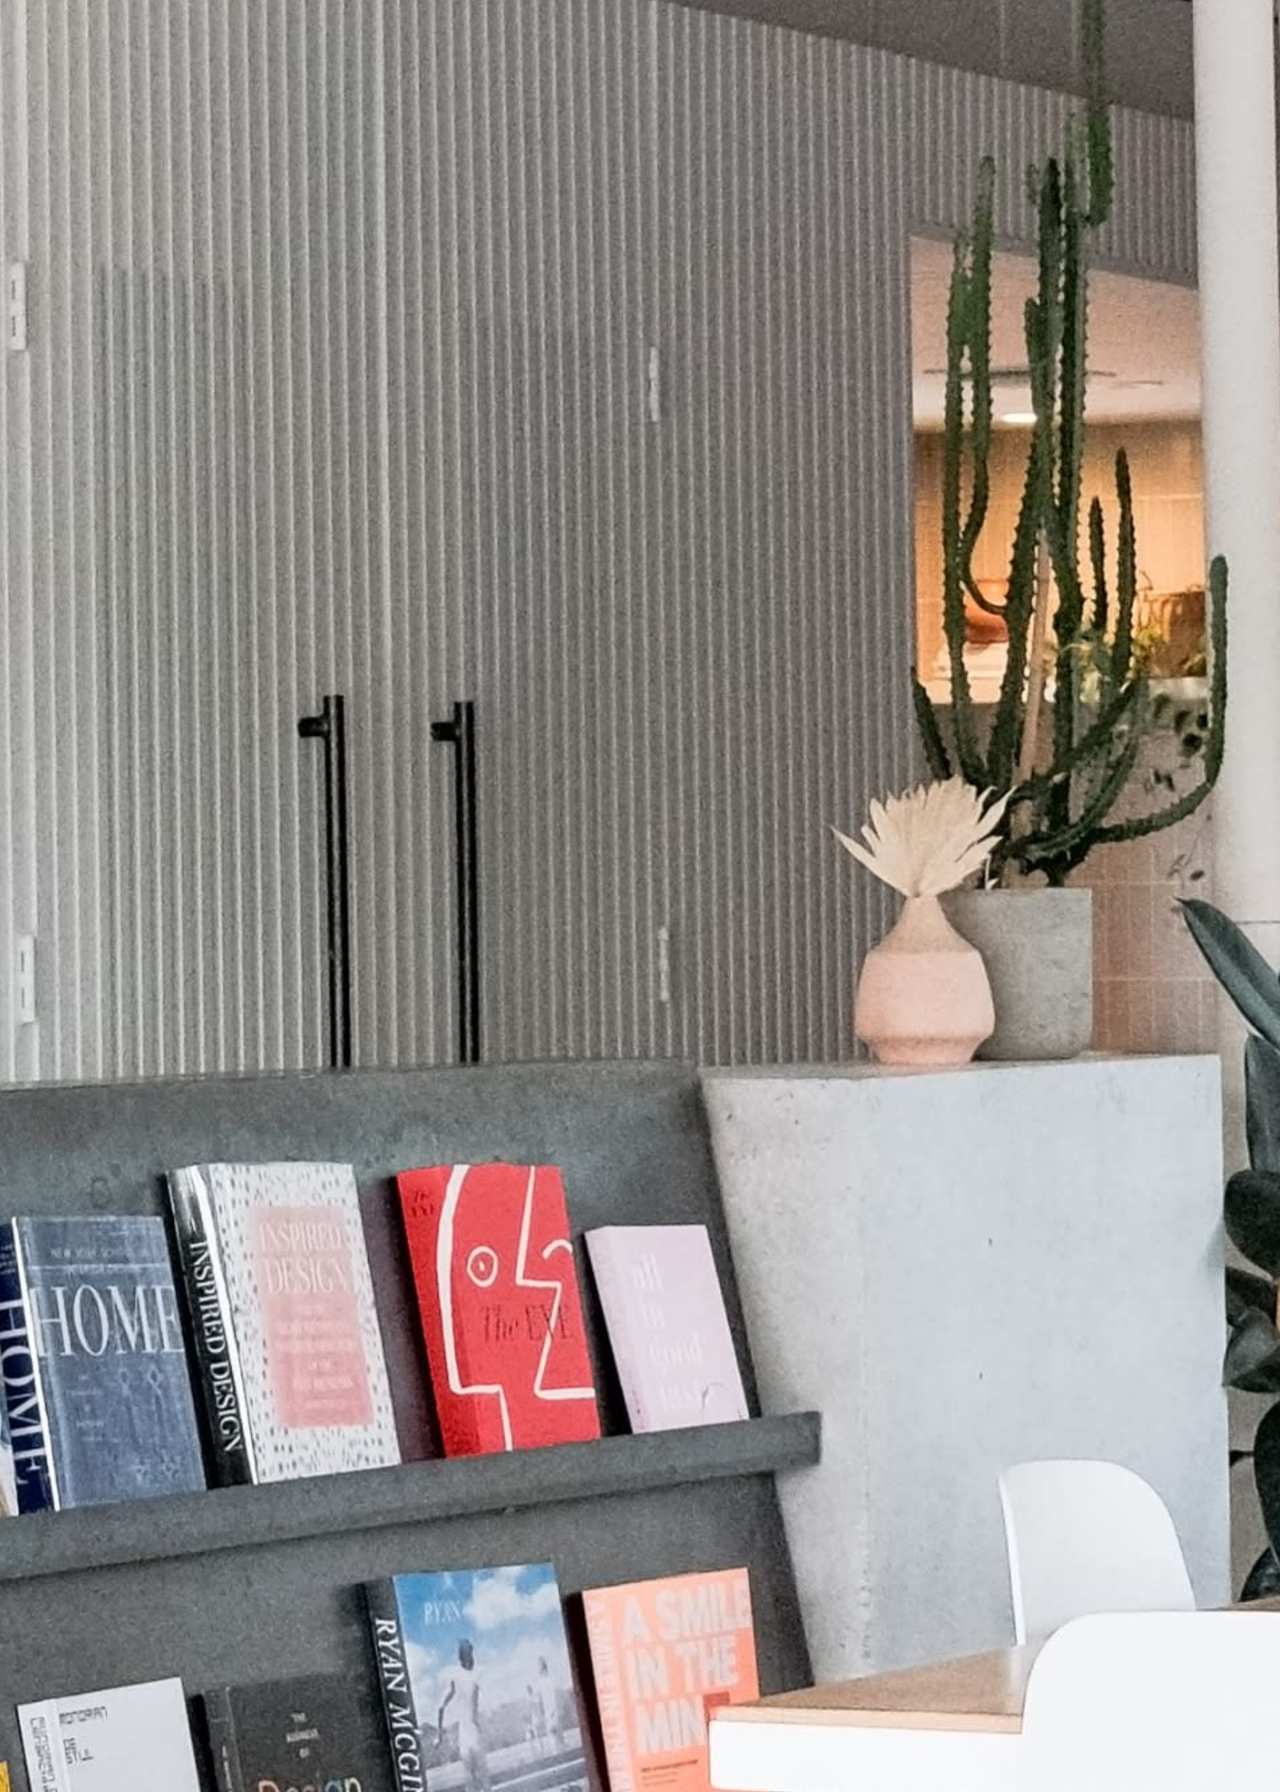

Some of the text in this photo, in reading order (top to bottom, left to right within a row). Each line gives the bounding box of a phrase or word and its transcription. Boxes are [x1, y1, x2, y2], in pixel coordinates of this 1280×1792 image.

[258, 1221, 350, 1252] INSPIRED
[263, 1255, 359, 1296] DESIGN
[29, 1283, 186, 1358] HOME
[189, 1240, 244, 1453] INSPIRED DESIGN
[375, 1618, 408, 1693] RYAN
[635, 1691, 731, 1755] MIN
